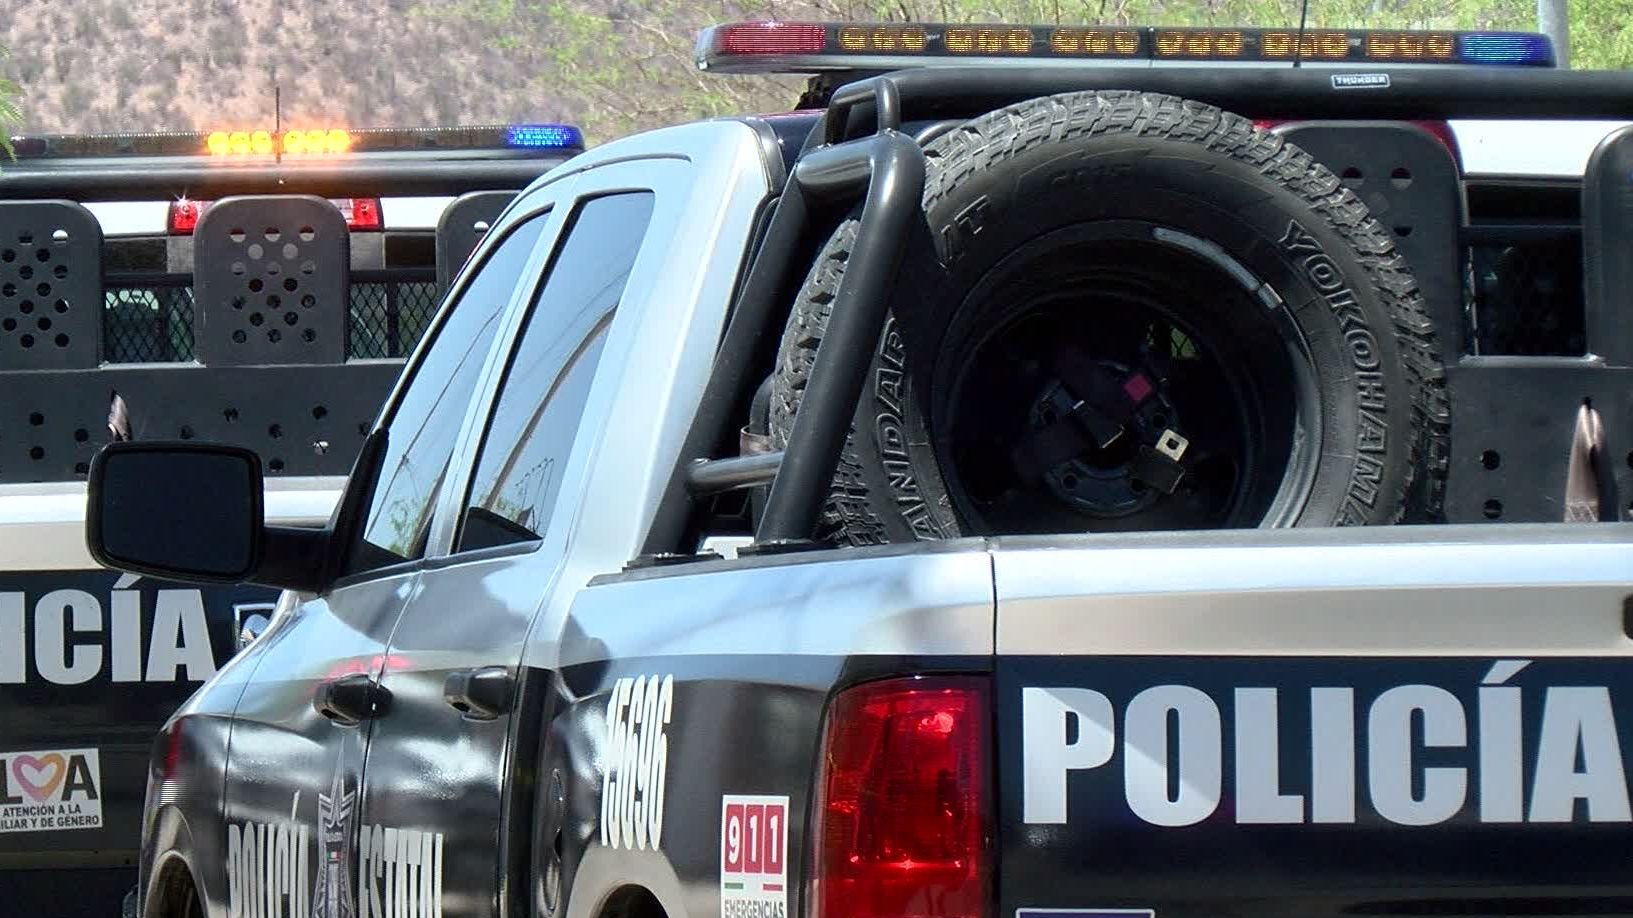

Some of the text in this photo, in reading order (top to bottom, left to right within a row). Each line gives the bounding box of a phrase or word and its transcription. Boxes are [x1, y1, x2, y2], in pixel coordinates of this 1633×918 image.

[1335, 76, 1386, 85] THUNDER
[1278, 219, 1387, 527] YOKOHAMA
[1022, 660, 1633, 827] POLICÍA
[3, 803, 81, 817] ATENCIÓN A LA
[30, 818, 38, 828] Y
[41, 818, 54, 828] DE
[728, 814, 780, 865] 911
[724, 899, 785, 918] EMERGENCIAS
